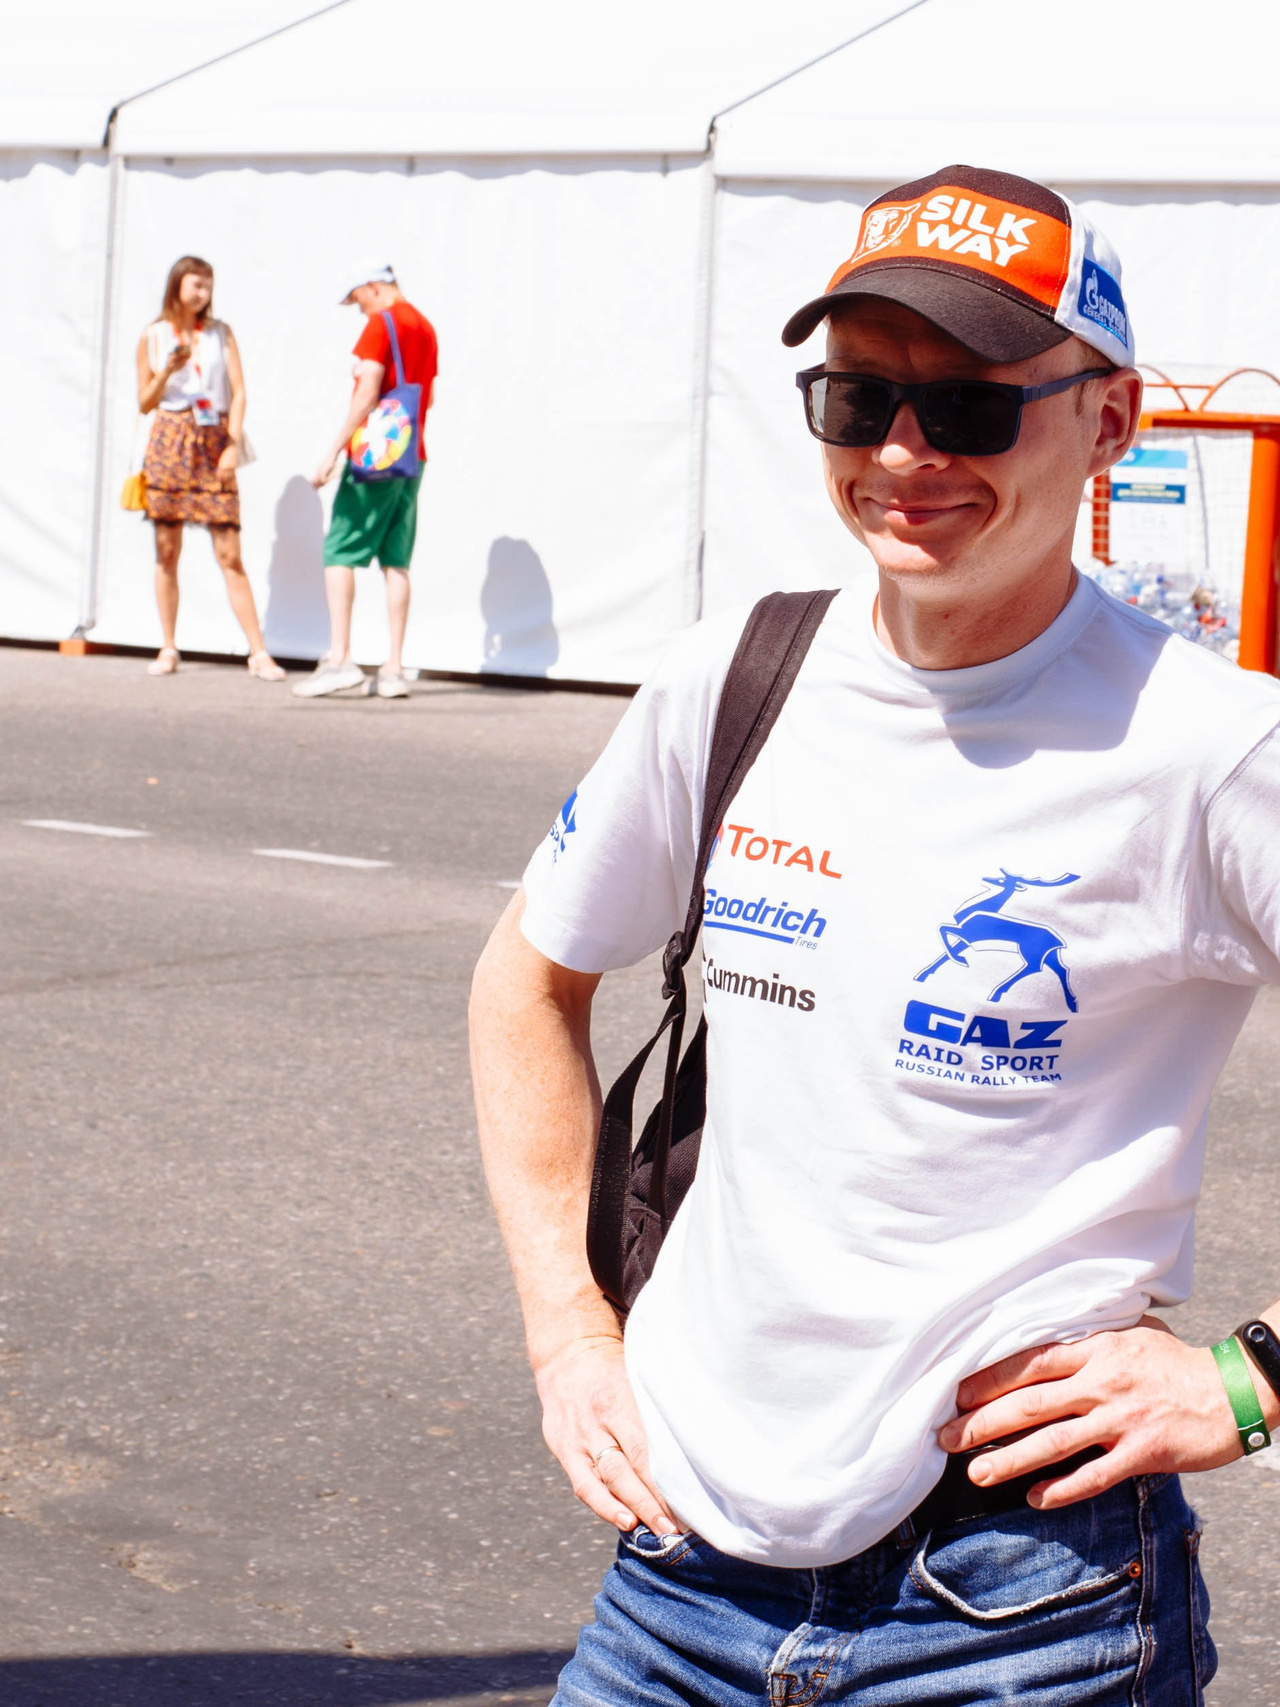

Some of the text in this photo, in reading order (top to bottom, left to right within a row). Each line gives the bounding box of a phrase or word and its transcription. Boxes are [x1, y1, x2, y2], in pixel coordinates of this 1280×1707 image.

[920, 195, 1037, 245] SILK
[916, 221, 1028, 267] WAY
[727, 824, 843, 879] TOTAL
[795, 936, 818, 950] Tires
[904, 999, 1068, 1049] GAZ
[895, 1058, 1062, 1086] RUSSIAN RALLY TEAM
[898, 1038, 1059, 1071] RAID SPORT
